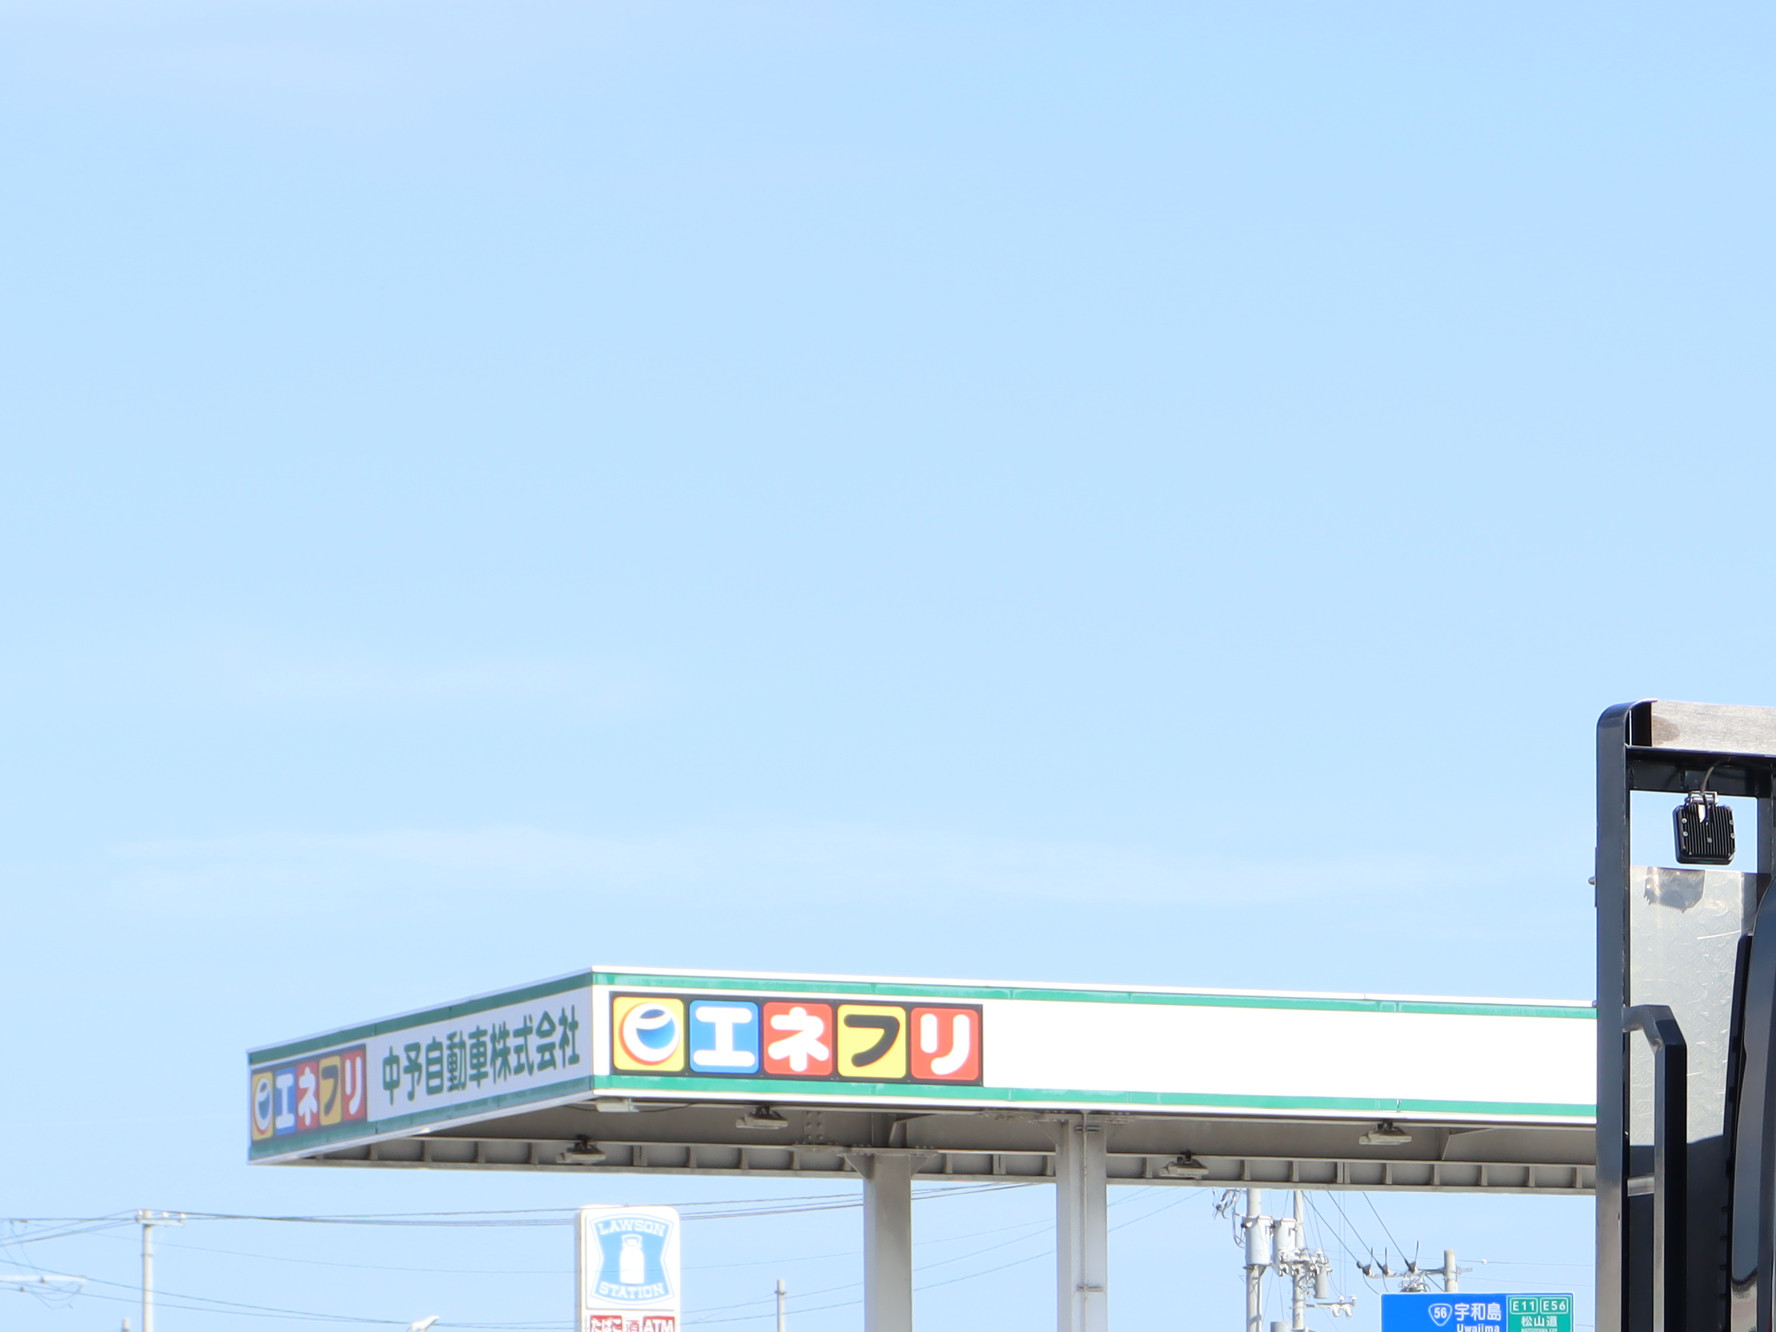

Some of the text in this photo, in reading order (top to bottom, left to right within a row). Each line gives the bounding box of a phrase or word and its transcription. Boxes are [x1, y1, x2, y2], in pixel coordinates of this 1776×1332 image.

[693, 1005, 971, 1076] エネフリ
[382, 1005, 581, 1106] 中予自動車株式会社
[275, 1056, 362, 1129] エネフリ
[598, 1219, 666, 1237] LAWSON
[599, 1281, 665, 1299] STATION
[1434, 1307, 1447, 1319] 56
[1454, 1302, 1502, 1321] 宇和島
[1512, 1300, 1535, 1311] E11
[1543, 1300, 1566, 1311] E56
[1521, 1315, 1558, 1327] 松山道
